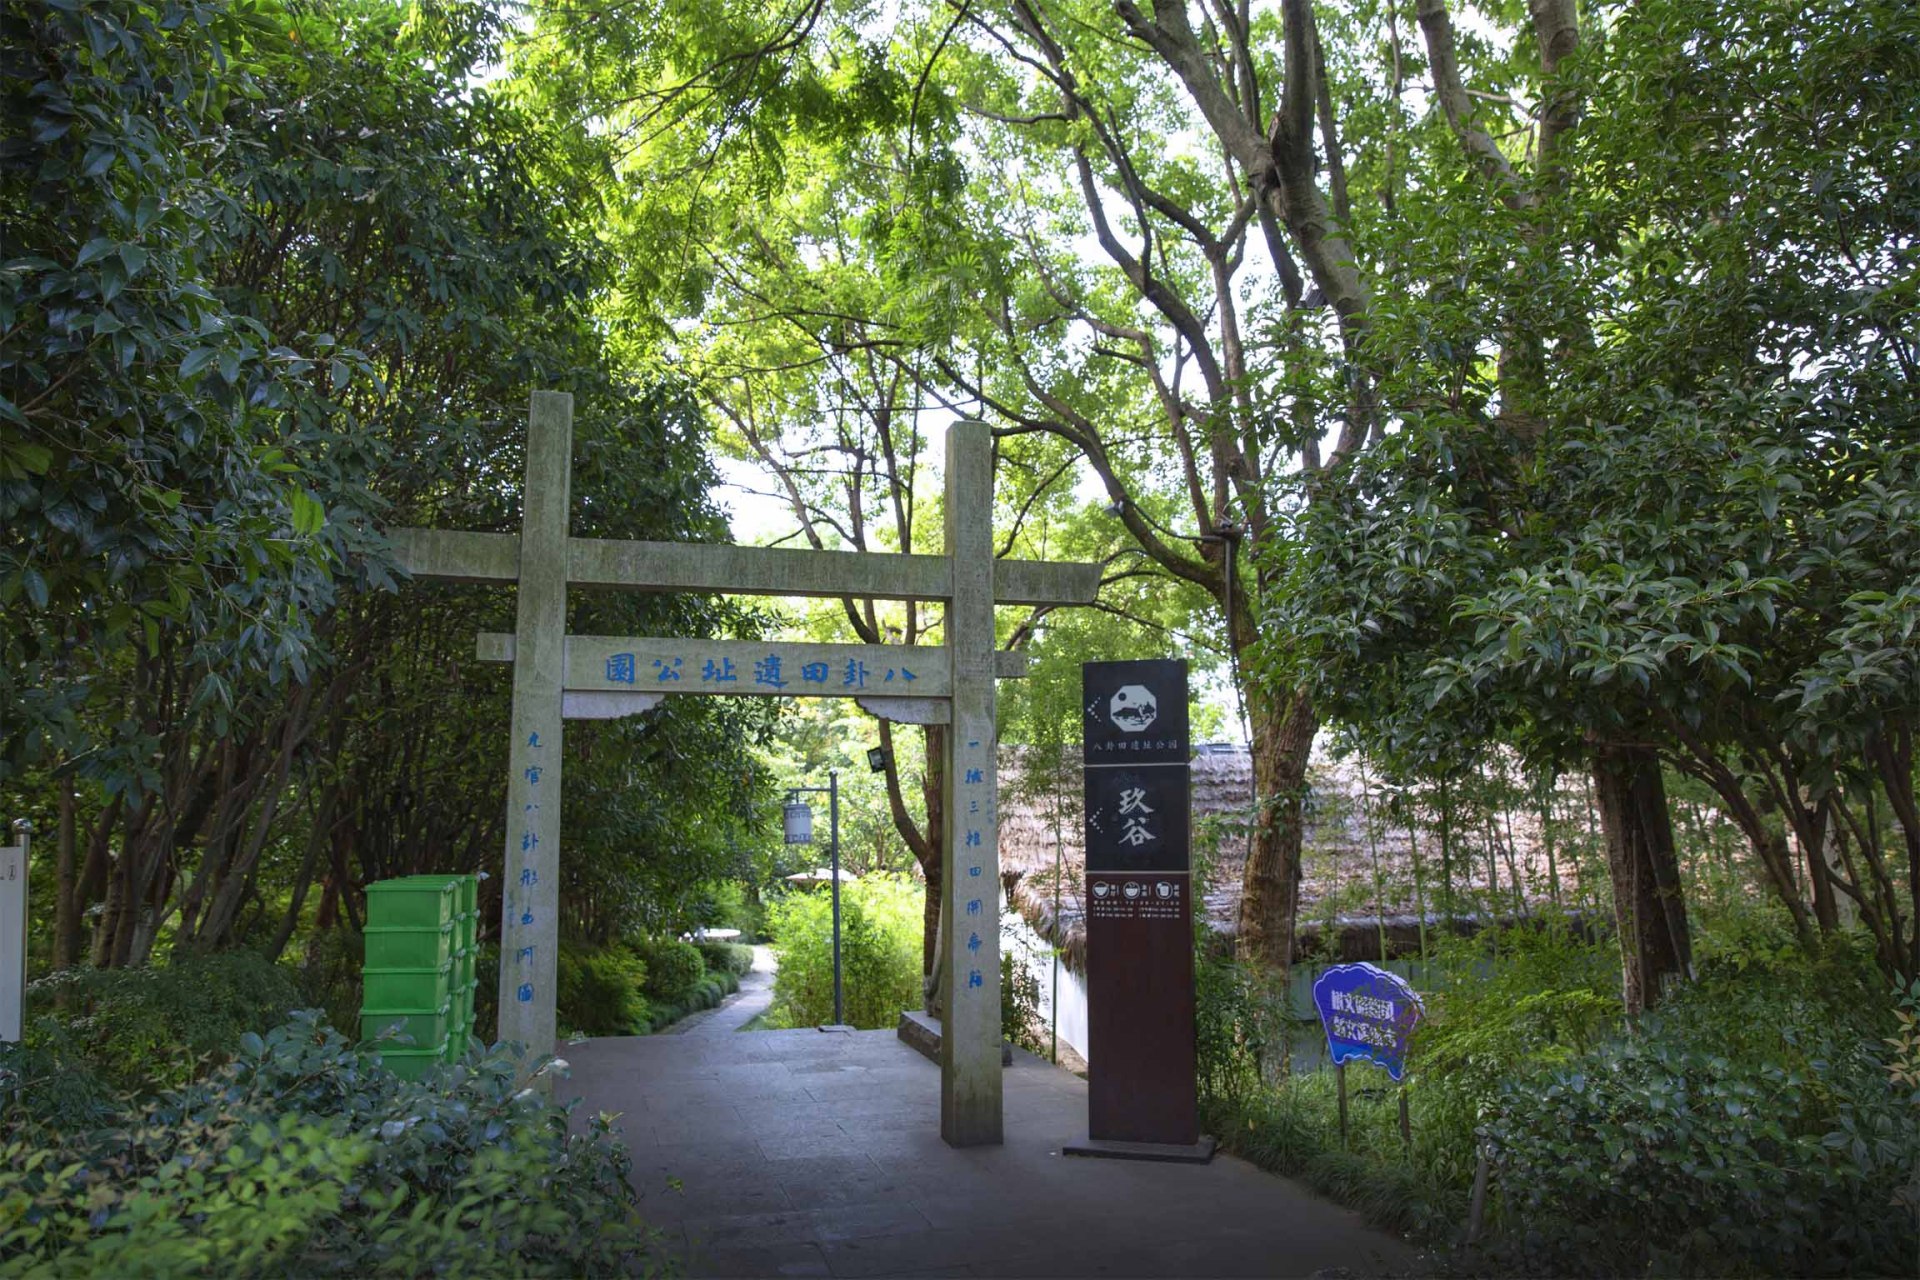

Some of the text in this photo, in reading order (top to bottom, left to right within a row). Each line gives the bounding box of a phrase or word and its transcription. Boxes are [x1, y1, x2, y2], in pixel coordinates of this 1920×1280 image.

[606, 653, 918, 688] 八卦田遺址公園
[1118, 787, 1156, 847] 玖谷
